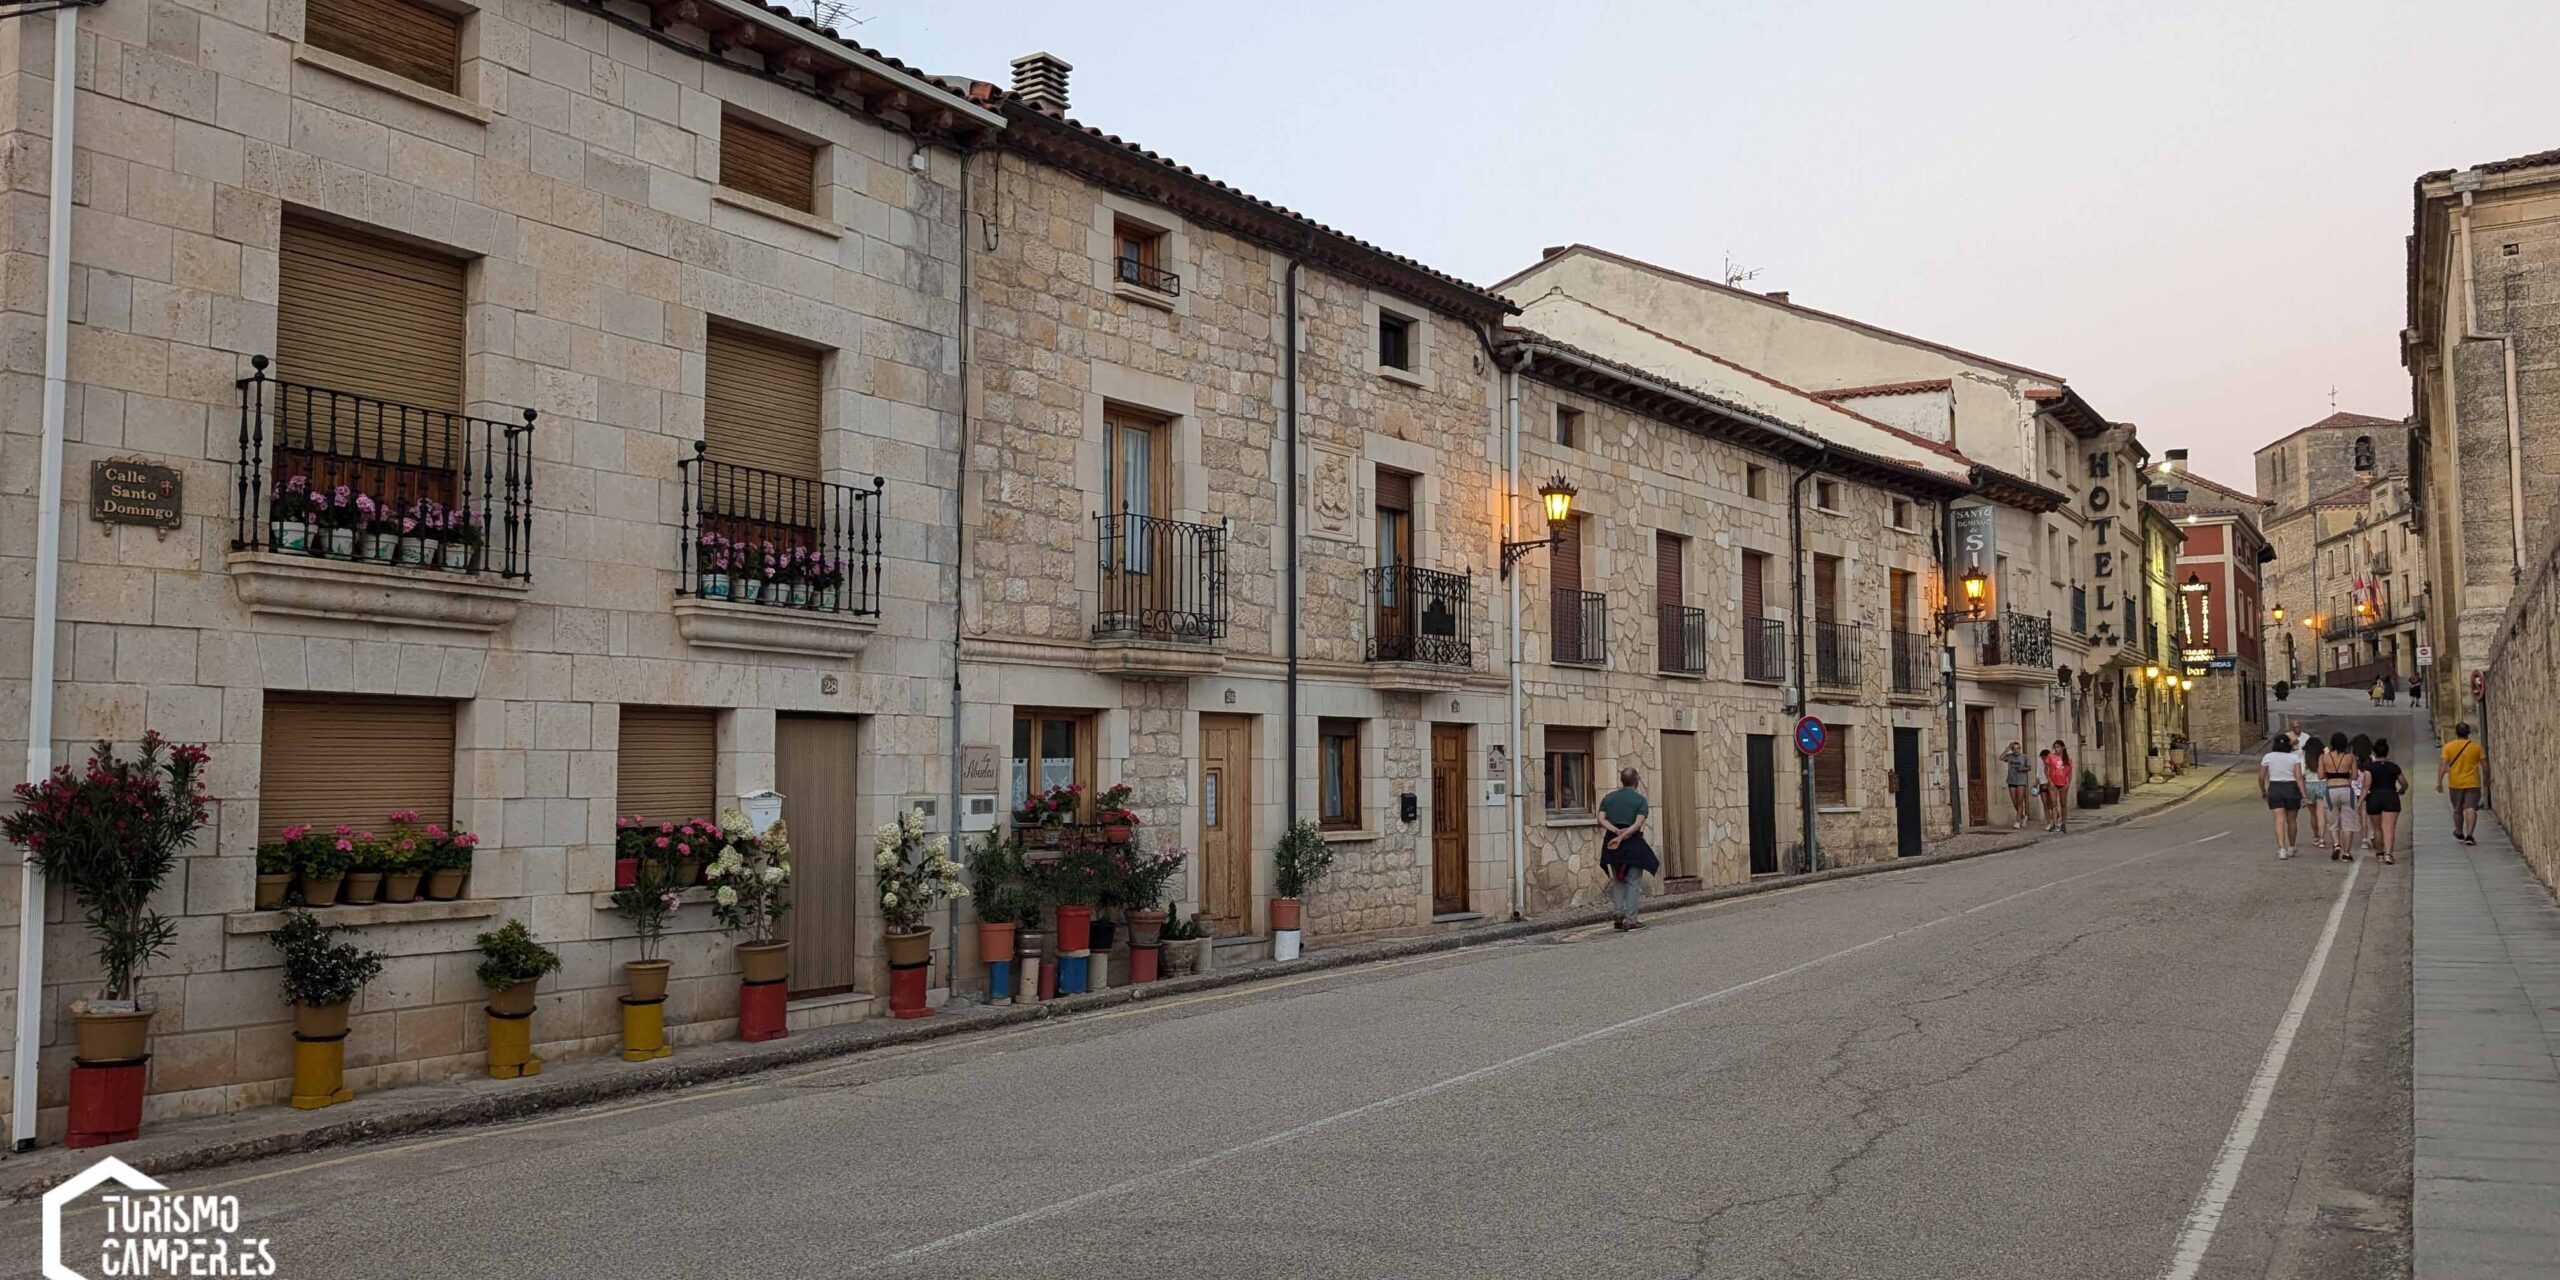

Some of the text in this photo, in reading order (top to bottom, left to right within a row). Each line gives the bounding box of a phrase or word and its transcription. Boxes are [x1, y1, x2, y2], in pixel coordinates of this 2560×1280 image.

[105, 468, 146, 483] Calle
[111, 484, 156, 501] Santo
[103, 499, 173, 519] Domingo
[1956, 507, 1992, 519] SANTO
[1957, 518, 1992, 528] DOMINGO
[2088, 452, 2114, 611] HOTEL
[2186, 665, 2206, 676] bar
[824, 679, 837, 692] 28
